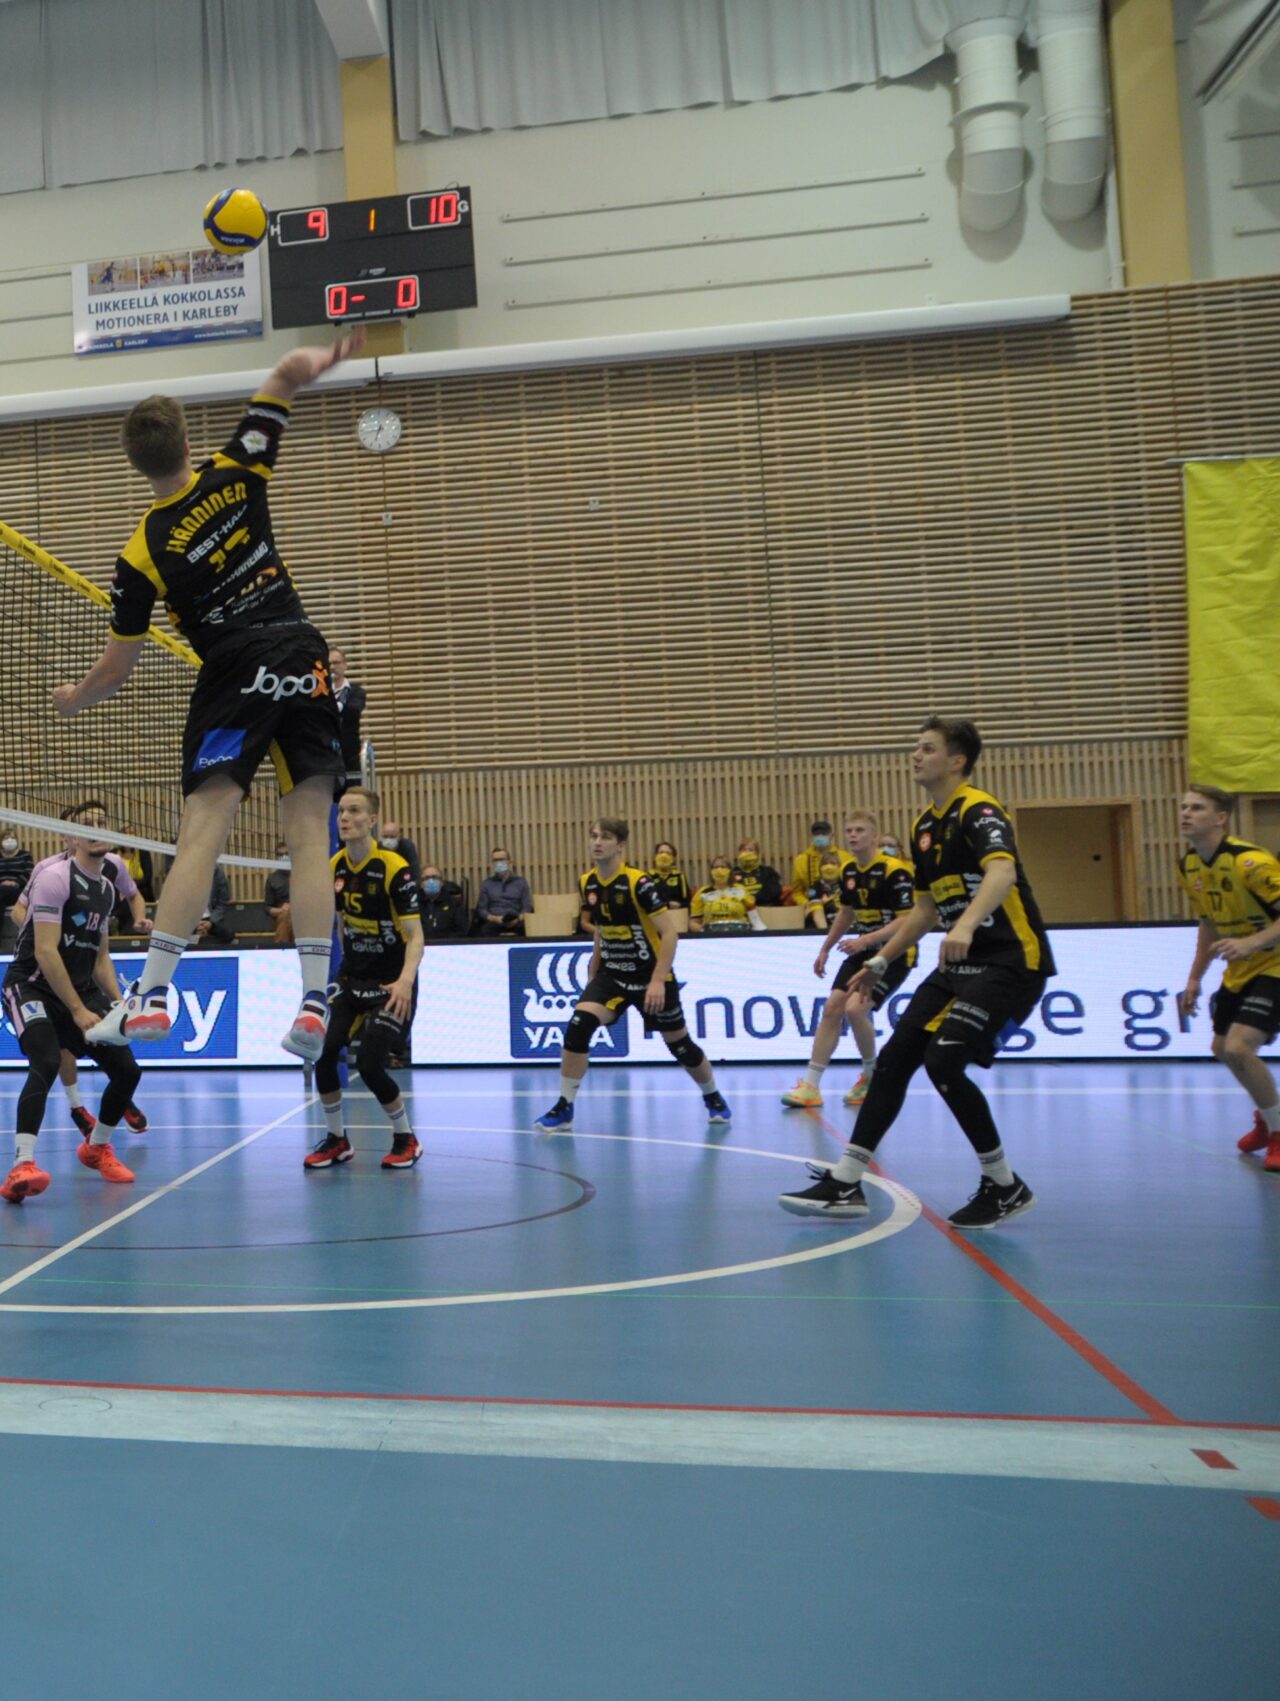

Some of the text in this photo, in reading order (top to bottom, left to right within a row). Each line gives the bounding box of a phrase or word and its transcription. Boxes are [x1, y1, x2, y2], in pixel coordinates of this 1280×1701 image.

[307, 210, 326, 237] 9
[369, 208, 376, 232] 1
[429, 194, 458, 224] 10
[458, 201, 469, 212] G
[88, 286, 246, 315] LIIKKEELLÄ KOKKOLASSA
[329, 286, 347, 315] 0
[398, 278, 416, 308] 0
[95, 313, 170, 331] MOTIONERA
[182, 304, 239, 322] KARLEBY
[343, 892, 363, 913] 15
[85, 912, 100, 931] 18
[523, 1025, 615, 1049] YAA
